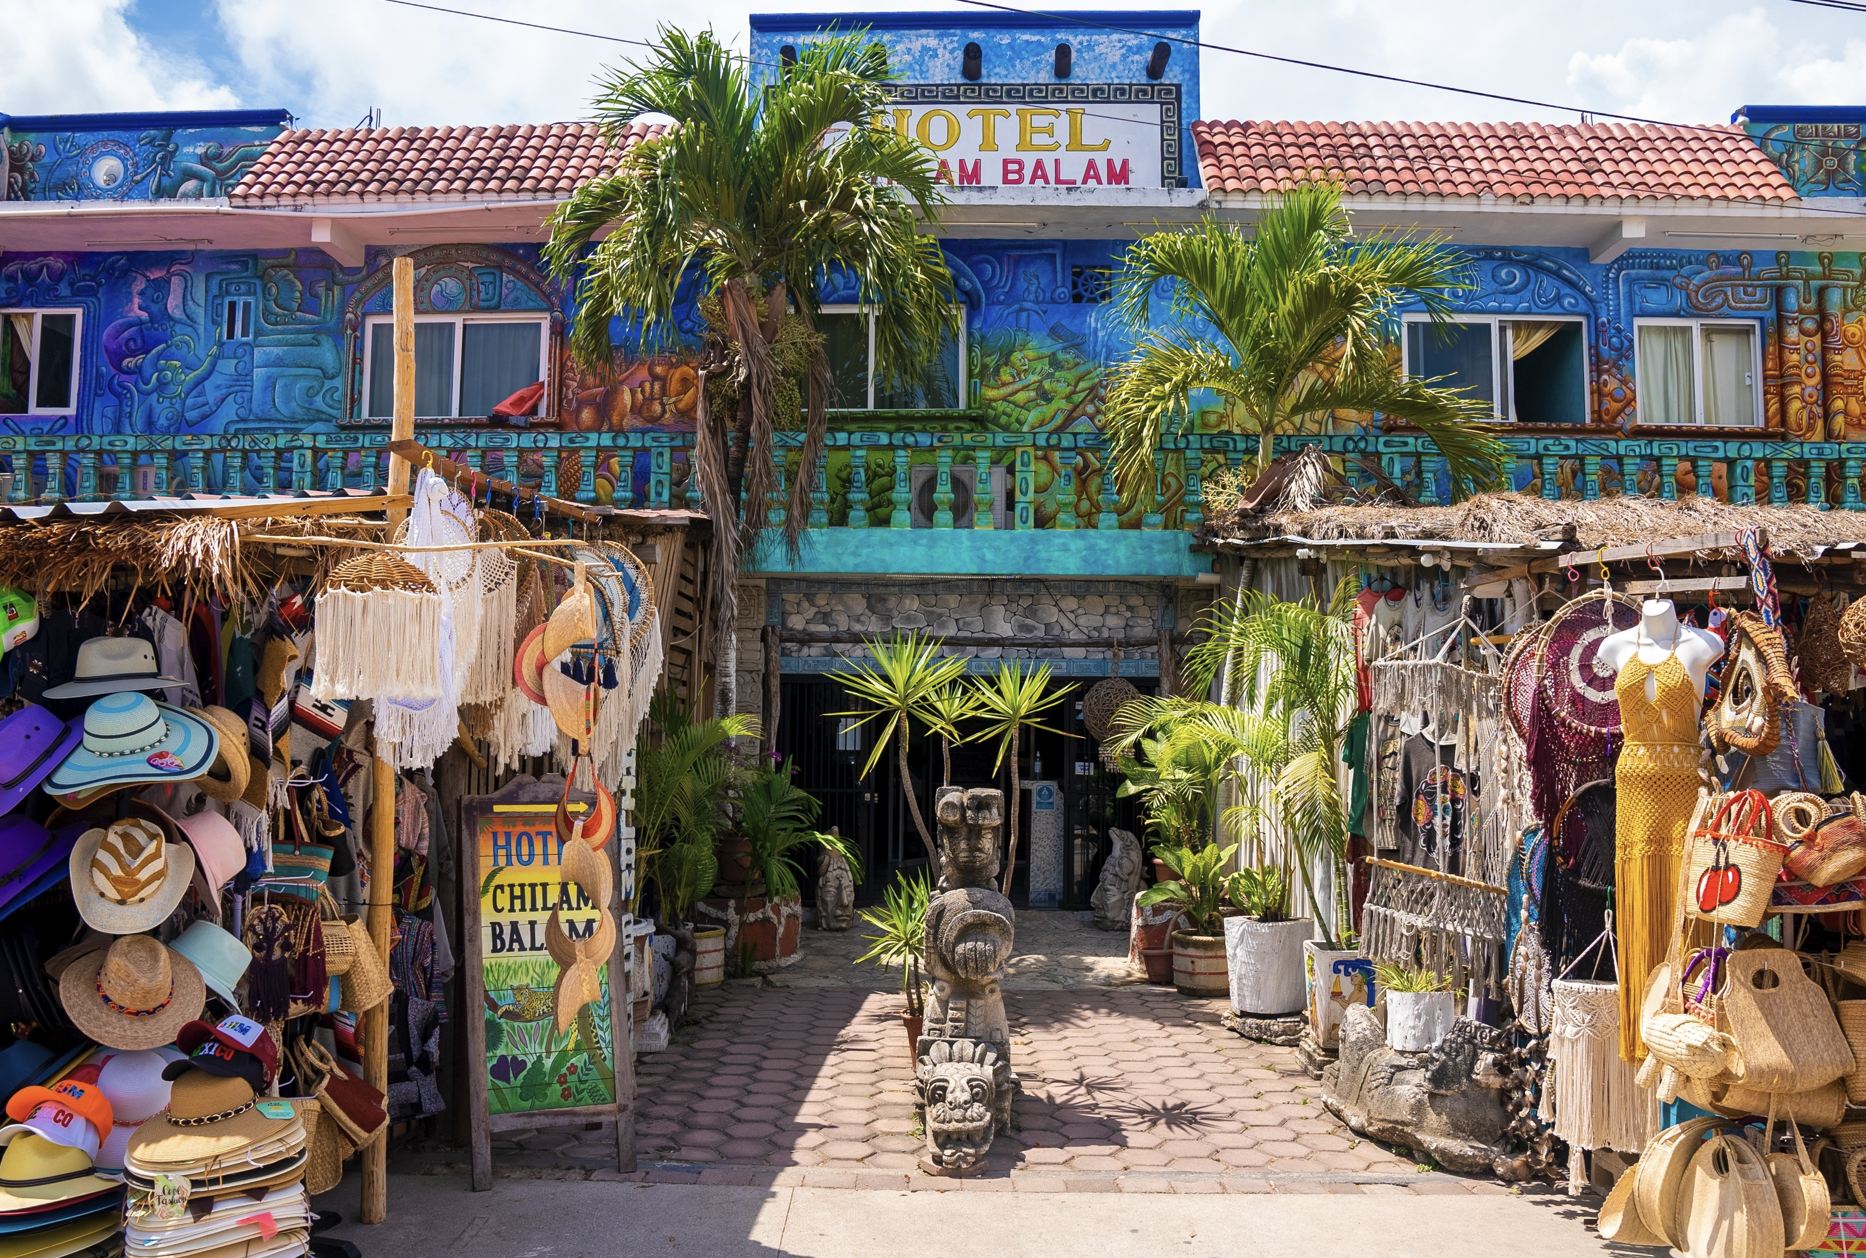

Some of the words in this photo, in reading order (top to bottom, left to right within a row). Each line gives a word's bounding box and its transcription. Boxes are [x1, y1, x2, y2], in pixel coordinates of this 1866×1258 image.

[872, 108, 1111, 152] HOTEL
[1001, 158, 1131, 185] BALAM
[621, 742, 636, 901] HILAM
[491, 831, 564, 867] HOT
[492, 882, 597, 913] CHILAM
[490, 919, 596, 953] BALM
